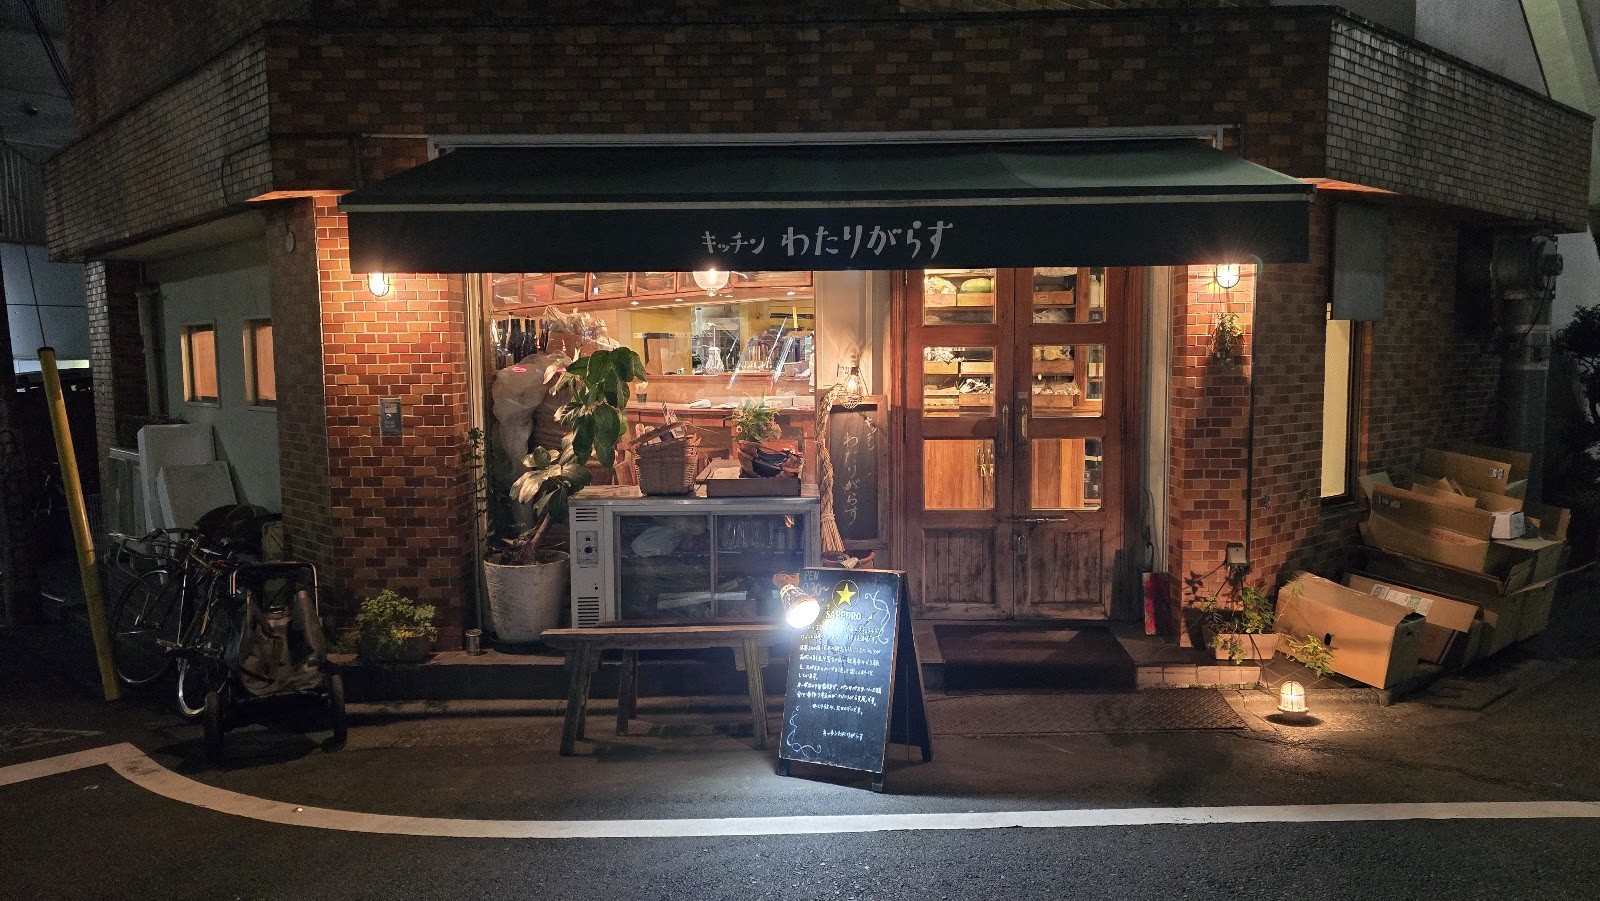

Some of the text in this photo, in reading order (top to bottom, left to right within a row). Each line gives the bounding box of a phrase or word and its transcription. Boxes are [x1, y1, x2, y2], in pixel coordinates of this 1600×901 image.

[701, 220, 954, 260] キッチン わたりがらす
[864, 416, 878, 451] キッチン
[843, 431, 861, 527] わたりがらす
[804, 570, 820, 581] PEN
[825, 610, 862, 621] SAPPORO
[822, 728, 864, 742] キッチンわたりがらす
